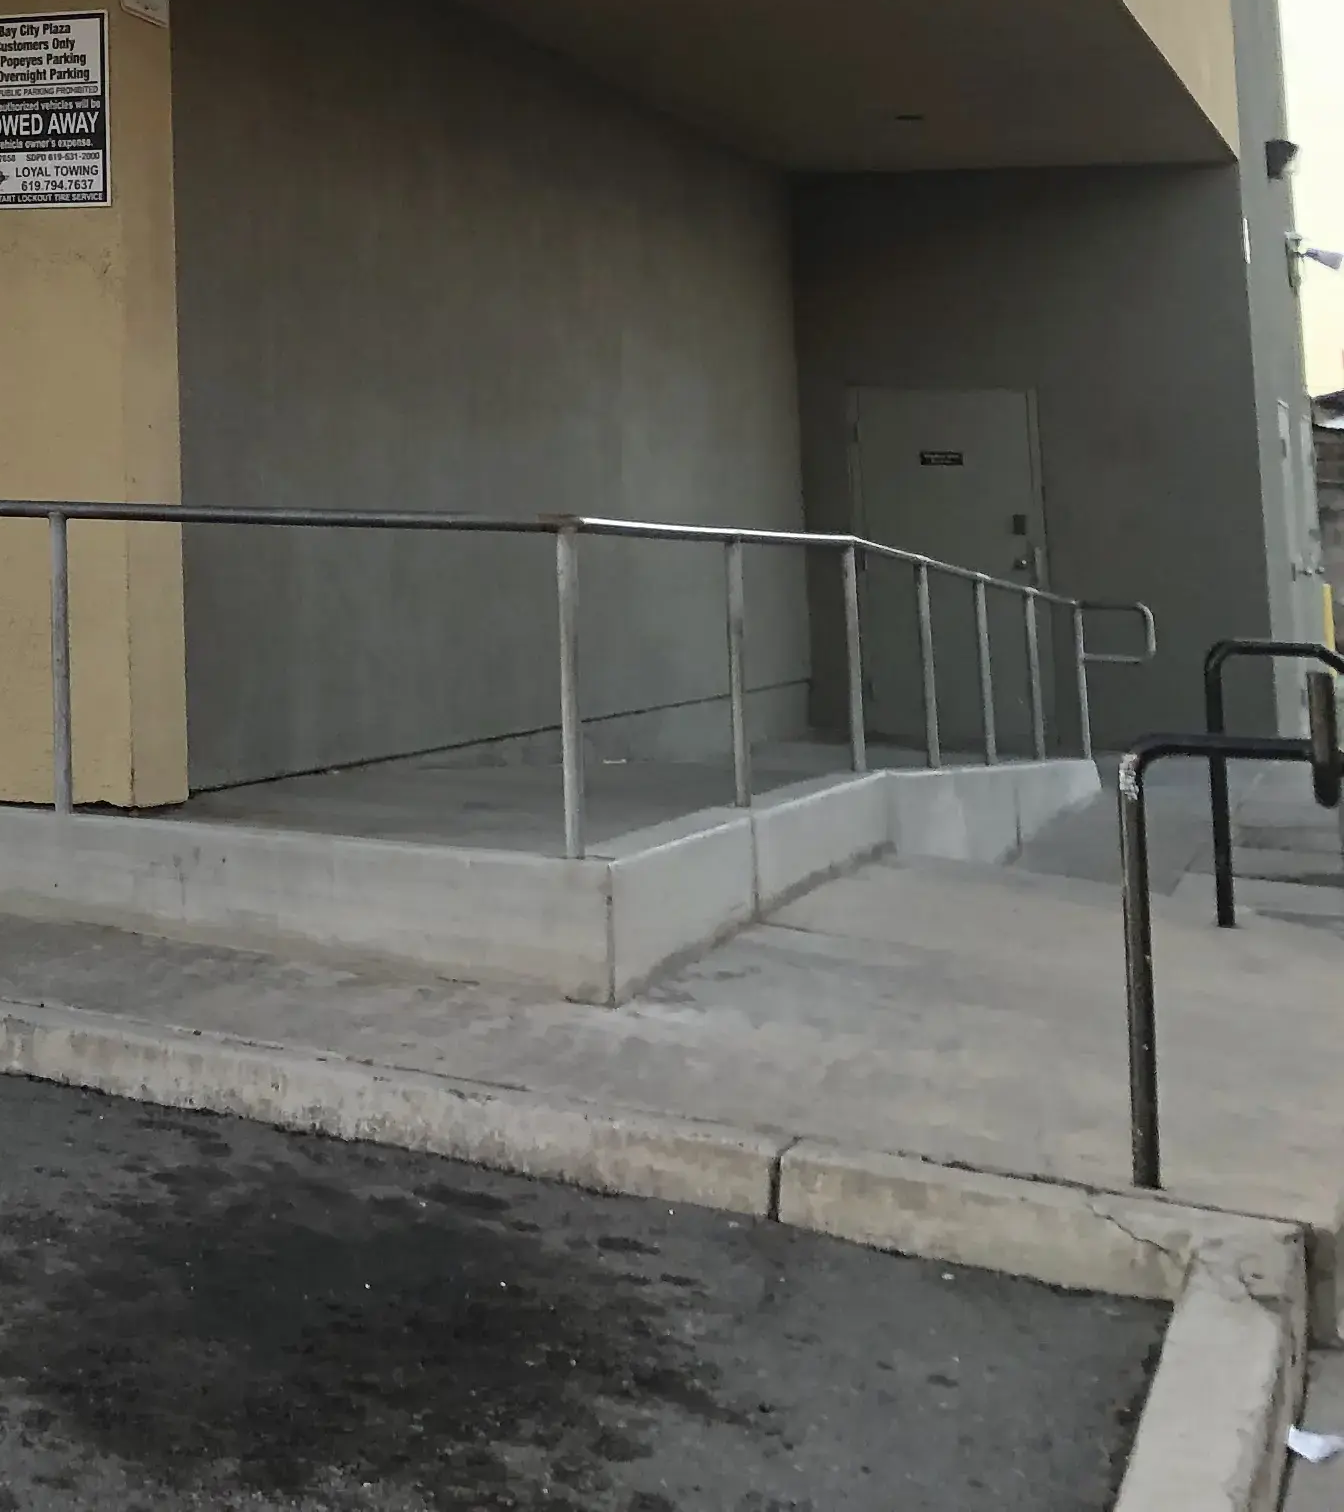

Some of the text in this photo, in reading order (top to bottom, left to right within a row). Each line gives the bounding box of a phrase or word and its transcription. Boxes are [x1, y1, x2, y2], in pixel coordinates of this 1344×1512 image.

[19, 24, 40, 38] City
[42, 23, 71, 35] Plaza
[52, 37, 75, 51] Only
[0, 55, 43, 69] Popeyes
[46, 53, 87, 66] Parking
[49, 68, 90, 81] Parking
[23, 87, 55, 96] PARKING
[55, 86, 99, 94] PROHIBITED
[41, 100, 73, 110] vehicles
[75, 99, 89, 109] will
[90, 99, 101, 109] be
[47, 111, 100, 135] AWAY
[25, 138, 56, 148] owner's
[57, 138, 94, 149] expense.
[15, 166, 51, 178] LOYAL
[54, 165, 99, 177] TOWING
[21, 179, 94, 191] 619.794.7637
[17, 194, 52, 202] LOCKOUT
[72, 193, 103, 201] SERVICE
